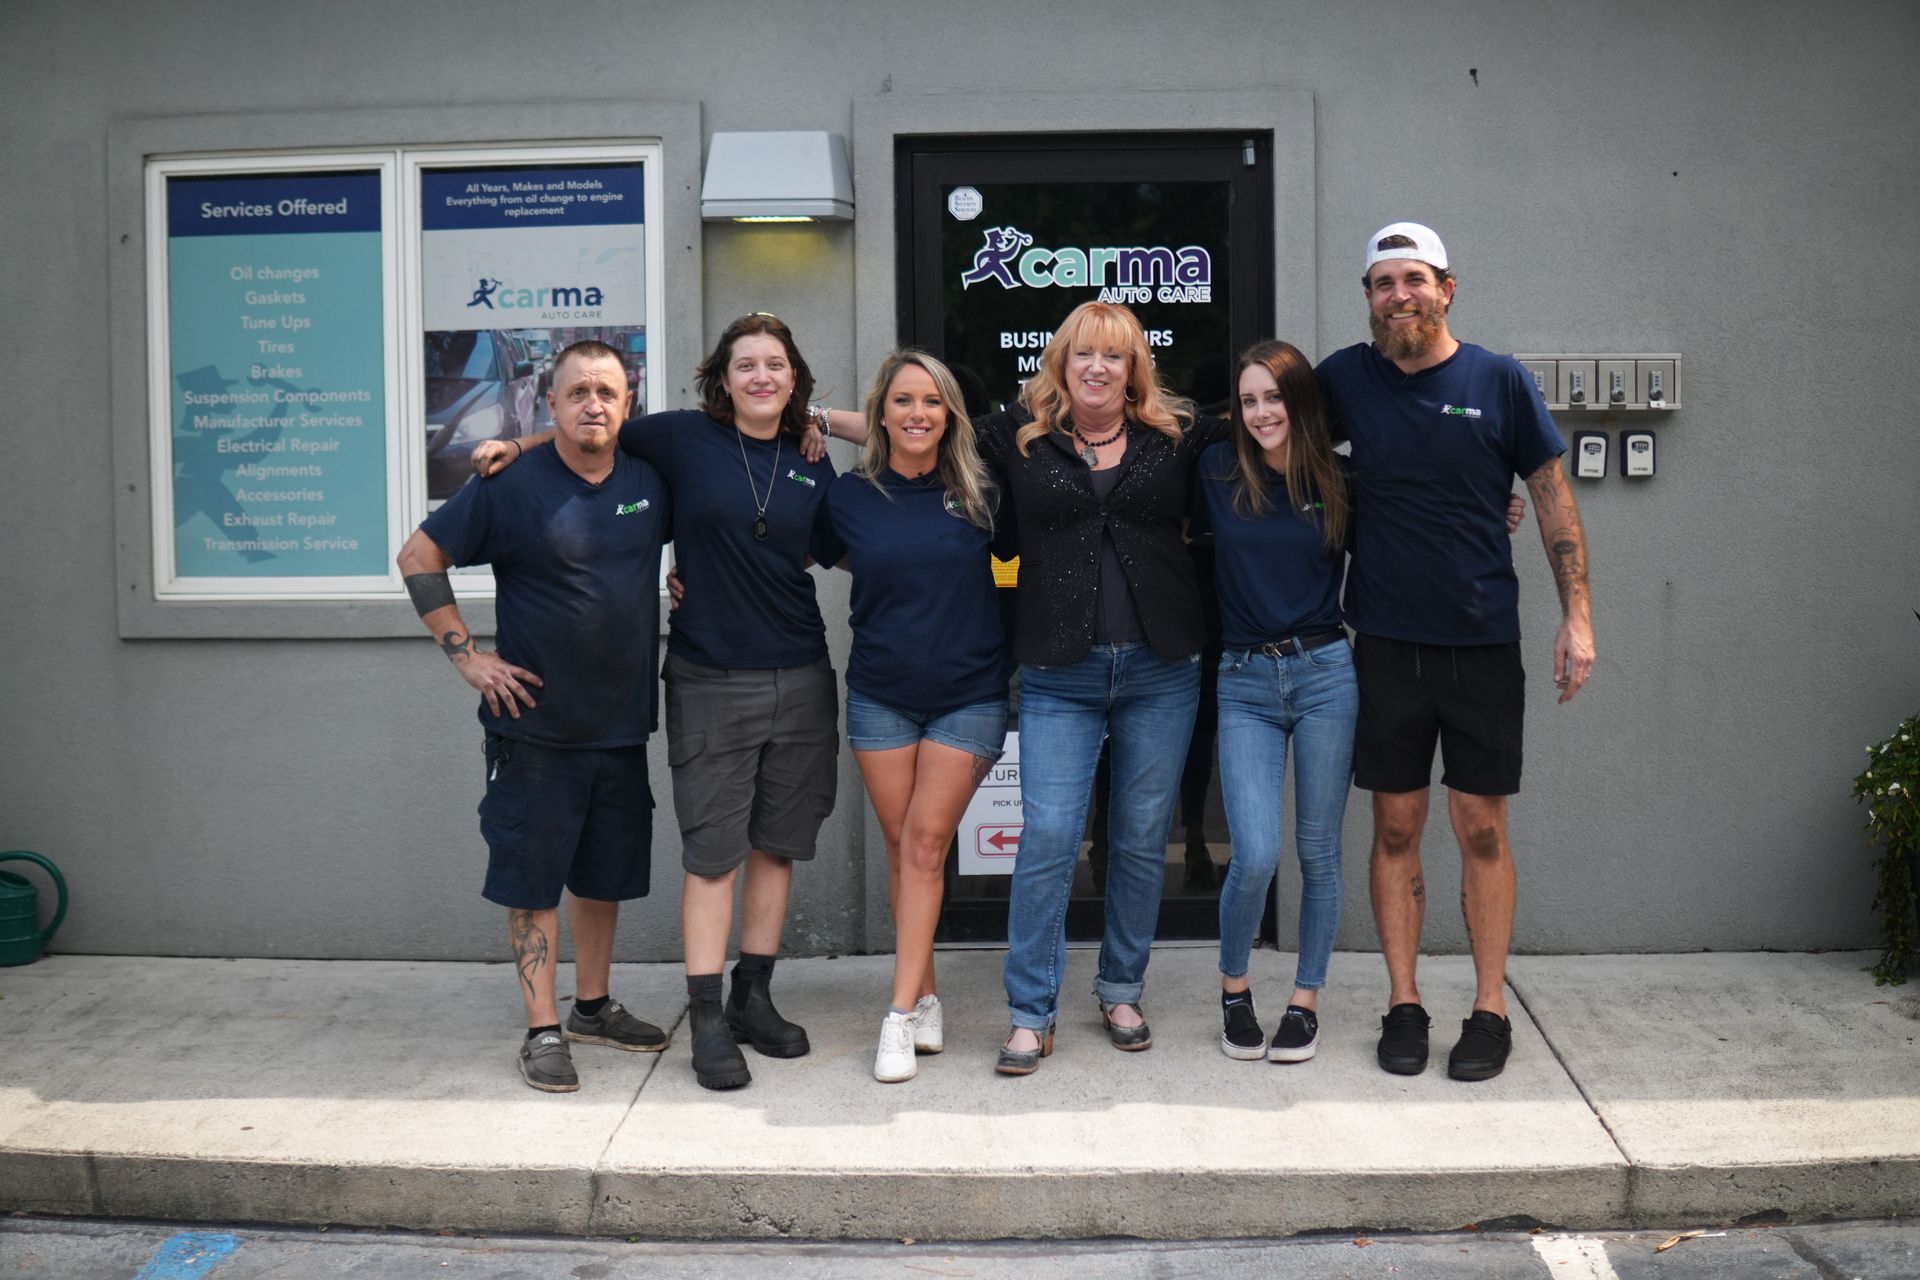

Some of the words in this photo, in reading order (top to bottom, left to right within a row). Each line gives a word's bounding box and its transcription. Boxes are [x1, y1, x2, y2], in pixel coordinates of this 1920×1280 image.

[466, 184, 479, 193] All
[482, 184, 510, 193] Years,
[513, 182, 544, 192] Makes
[546, 181, 564, 191] and
[567, 180, 603, 190] Models
[446, 195, 497, 208] Everything
[500, 195, 522, 204] from
[525, 194, 537, 203] oil
[539, 193, 574, 206] change
[577, 194, 587, 202] to
[590, 192, 623, 204] engine
[201, 202, 273, 218] Services
[278, 198, 347, 216] Offered
[505, 207, 564, 218] replacement
[230, 266, 252, 280] Oil
[257, 266, 320, 282] changes
[1019, 246, 1212, 288] carma
[245, 291, 306, 304] Gaskets
[498, 287, 603, 308] carma
[1099, 286, 1152, 304] AUTO
[1158, 286, 1212, 303] CARE
[541, 312, 570, 320] AUTO
[574, 311, 602, 319] CARE
[240, 316, 276, 329] Tune
[281, 316, 311, 331] Ups
[258, 340, 295, 354] Tires
[251, 365, 303, 379] Brakes
[184, 391, 269, 406] Suspension
[274, 389, 372, 406] Components
[194, 415, 294, 429] Manufacturer
[300, 414, 362, 427] Services
[217, 439, 285, 453] Electrical
[291, 438, 340, 454] Repair
[236, 464, 322, 480] Alignments
[236, 488, 324, 501] Accessories
[224, 512, 283, 526] Exhaust
[288, 512, 337, 528] Repair
[204, 537, 298, 550] Transmission
[304, 536, 358, 550] Service
[993, 800, 1011, 808] PICK
